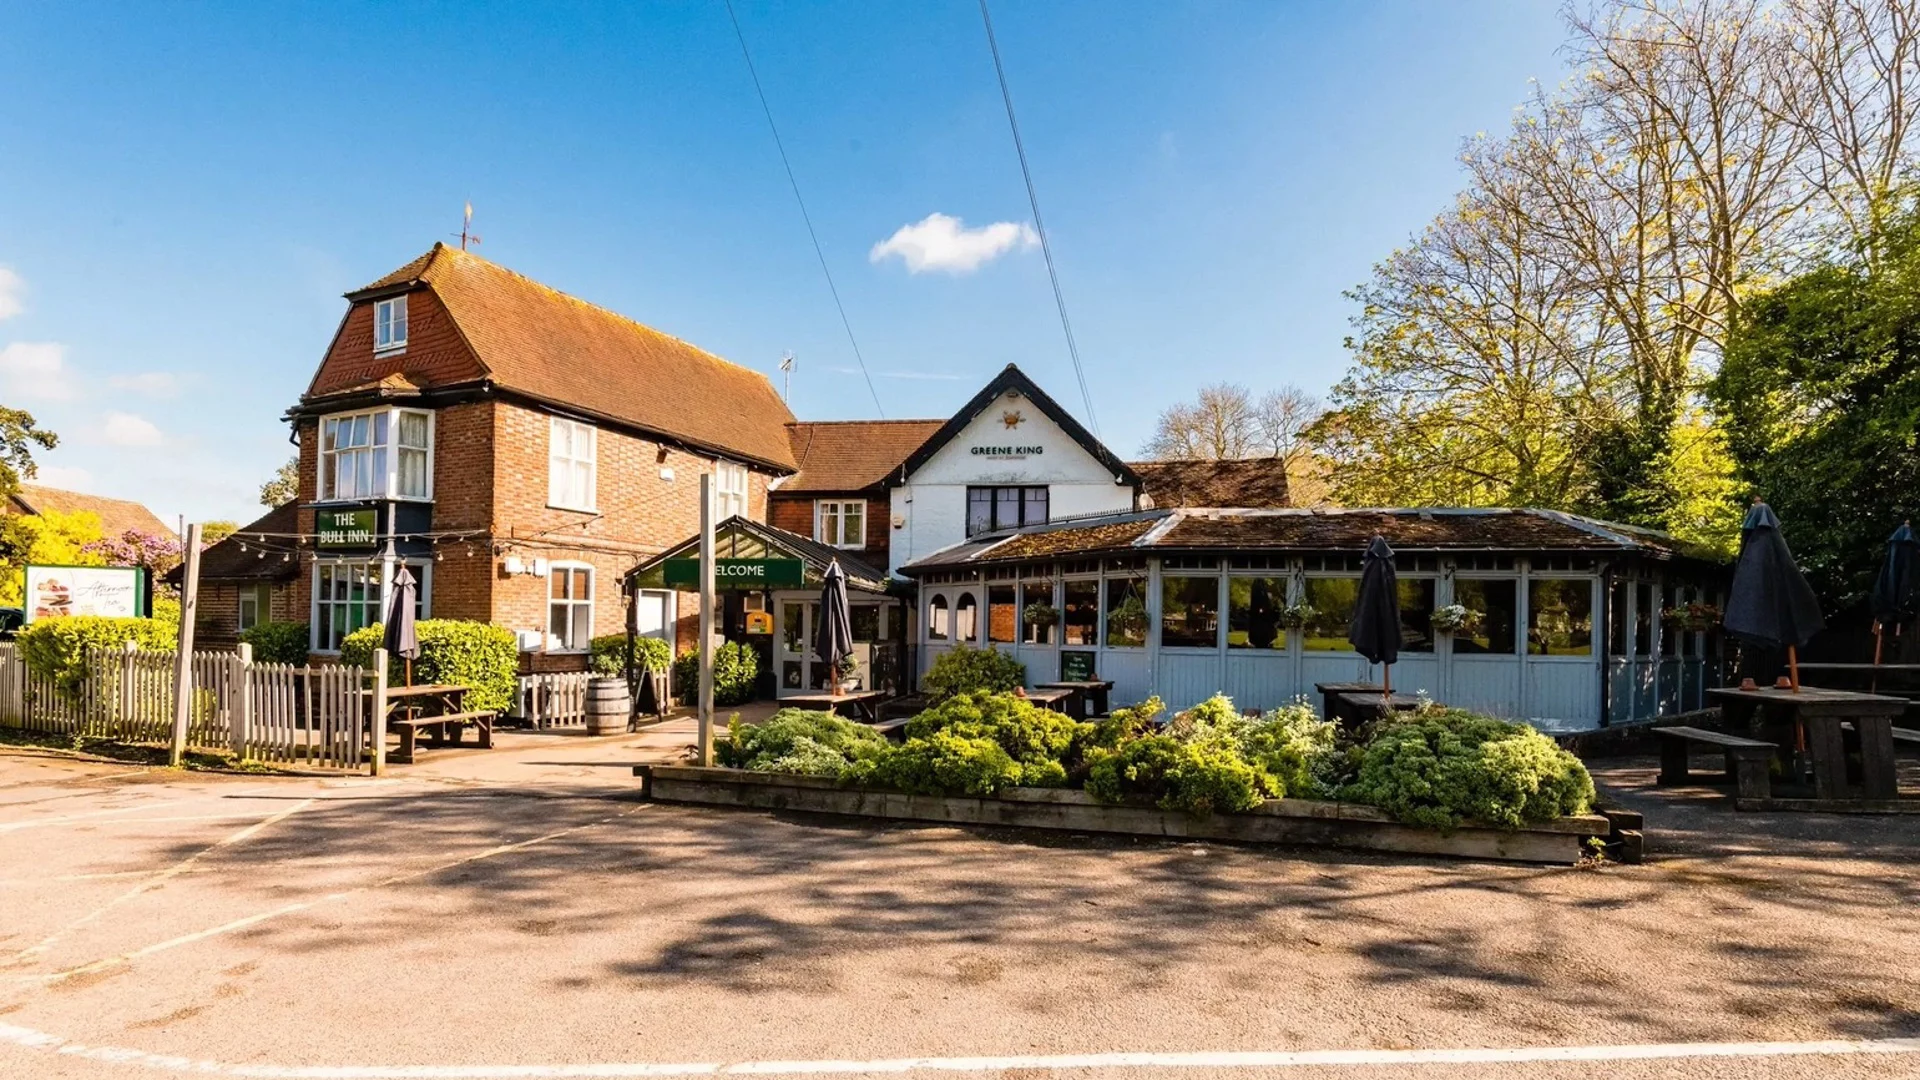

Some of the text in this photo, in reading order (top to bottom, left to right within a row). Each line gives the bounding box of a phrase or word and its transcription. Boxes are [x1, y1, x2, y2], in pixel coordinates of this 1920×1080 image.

[970, 446, 1043, 455] GREENE KING
[334, 513, 355, 526] THE
[320, 530, 369, 543] BULL INN
[715, 565, 765, 576] ELCOME
